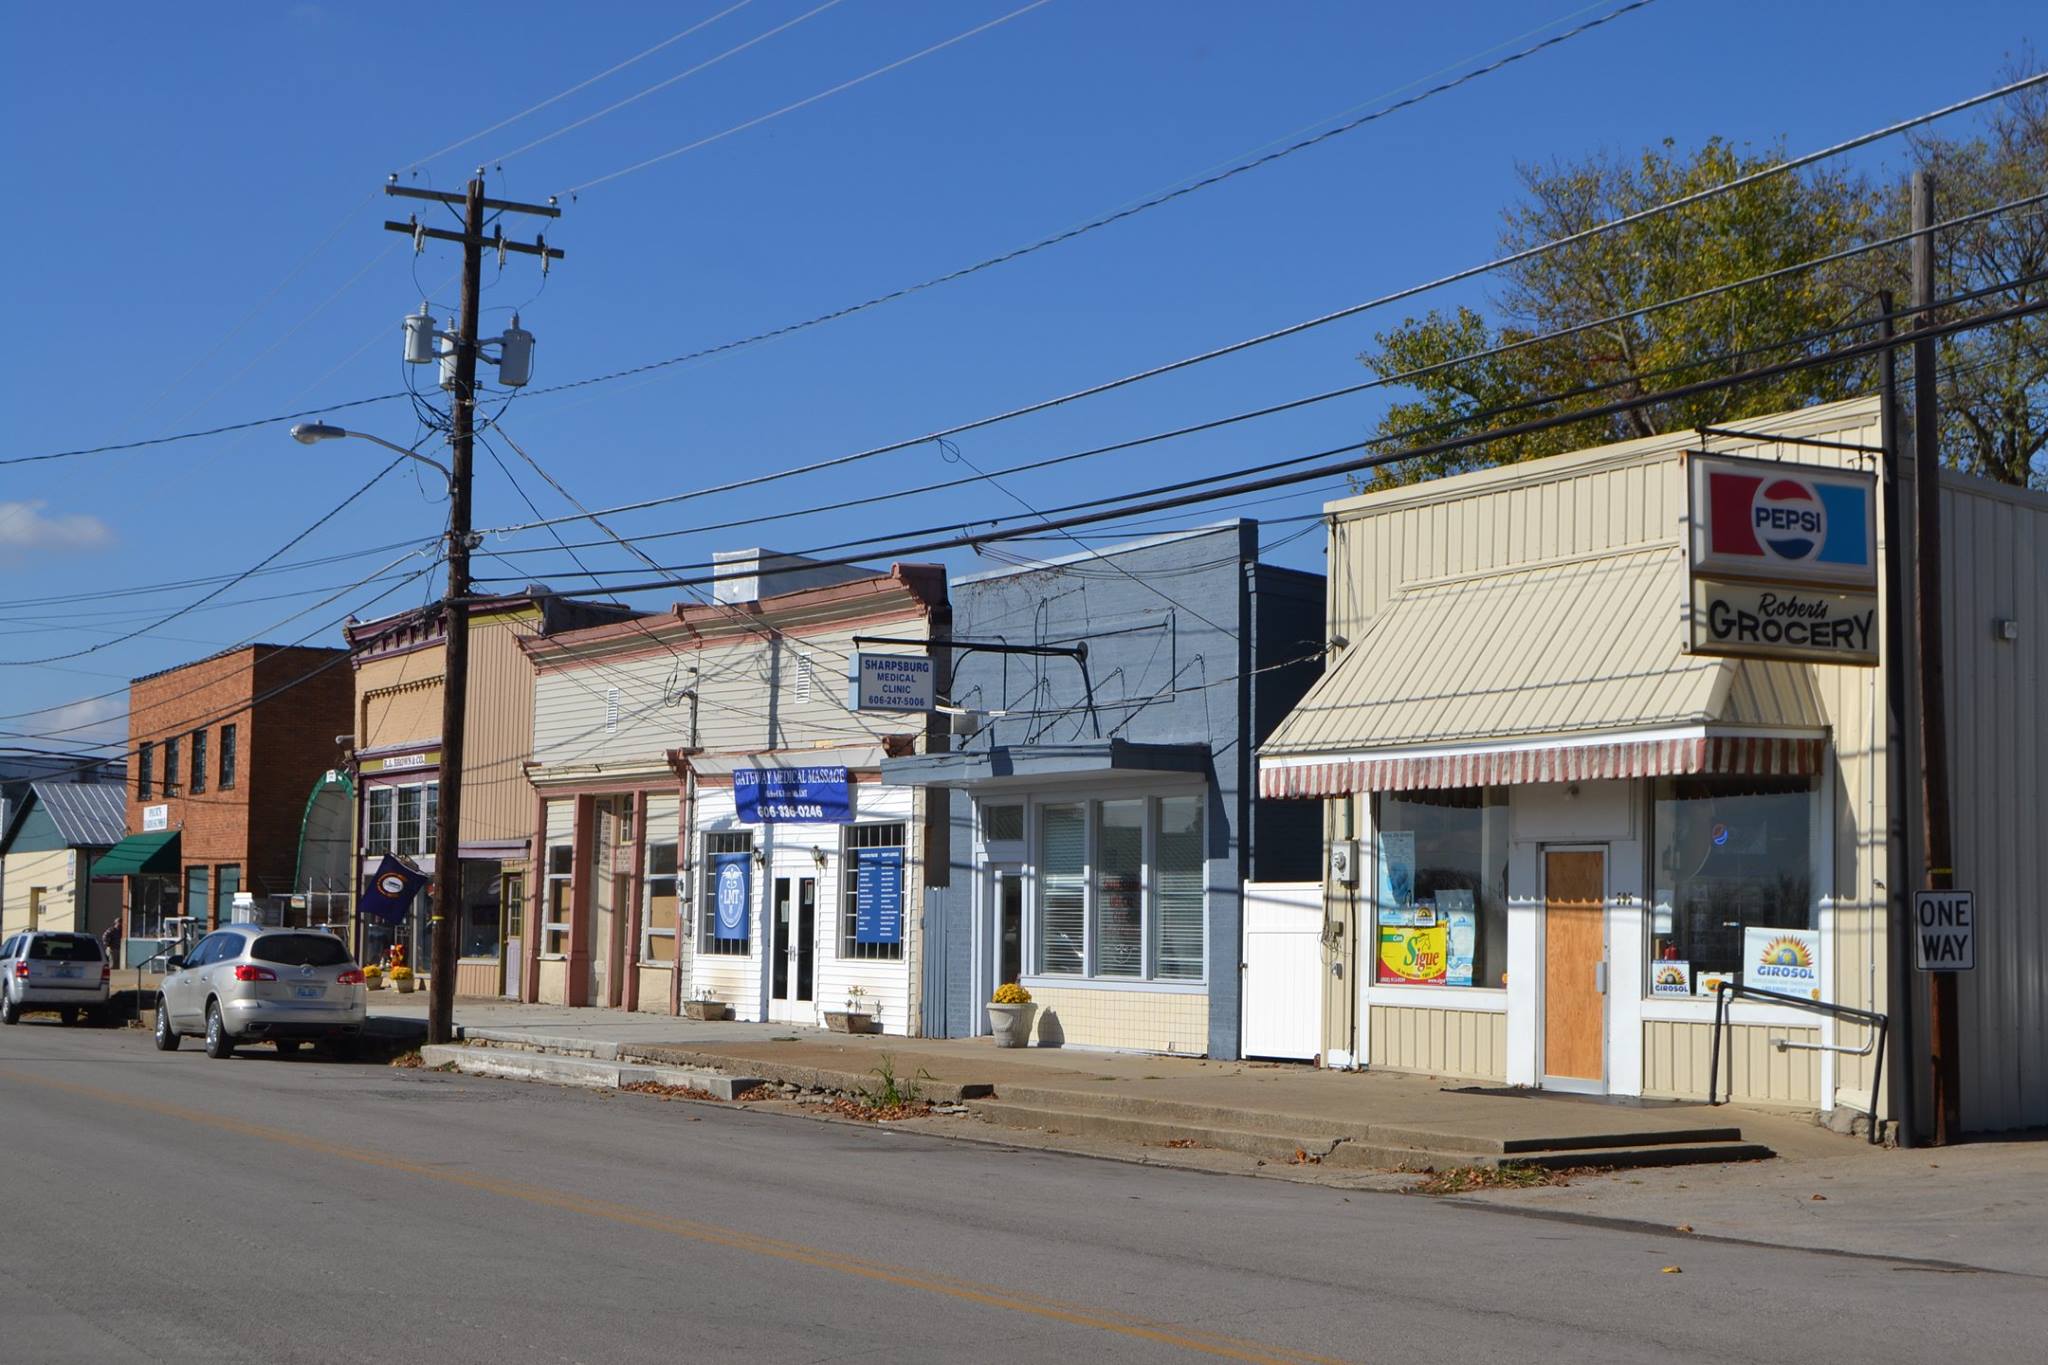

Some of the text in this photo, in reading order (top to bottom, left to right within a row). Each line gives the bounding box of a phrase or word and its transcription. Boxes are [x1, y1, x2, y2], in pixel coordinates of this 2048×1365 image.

[1755, 507, 1821, 533] PEPSI
[1758, 592, 1829, 620] Roberts
[1709, 599, 1874, 650] GROCERY
[865, 659, 929, 673] SHARPSBURG
[877, 672, 917, 683] MEDICAL
[882, 684, 911, 694] CLINIC
[868, 695, 925, 706] 606-247-5006
[735, 768, 845, 785] GATEWAY MEDICAL MASSAGE
[1920, 900, 1969, 927] ONE
[1403, 936, 1440, 972] Sigue
[1922, 935, 1969, 962] WAY
[1757, 966, 1814, 979] GIROSOL
[1655, 985, 1689, 993] GIROSOL
